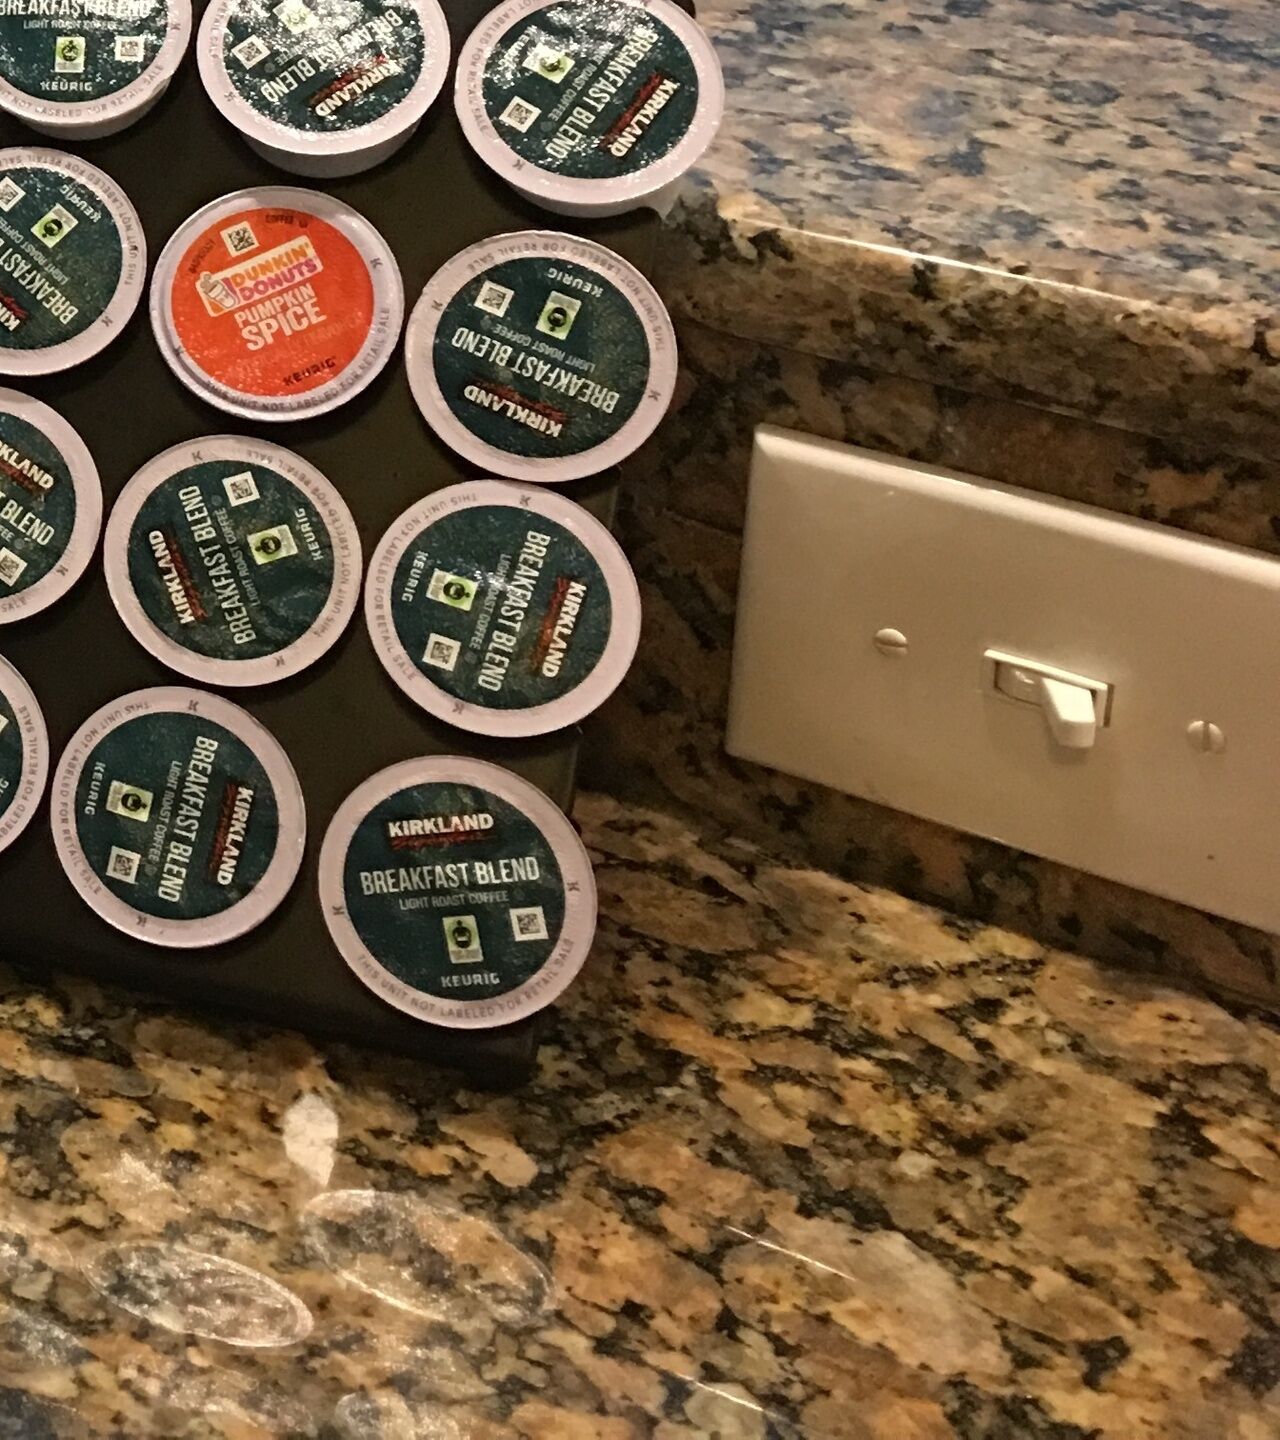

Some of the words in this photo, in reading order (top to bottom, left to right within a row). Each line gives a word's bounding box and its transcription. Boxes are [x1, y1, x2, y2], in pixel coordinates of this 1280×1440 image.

[40, 81, 93, 91] KEURIG
[260, 61, 316, 101] BLEND
[315, 60, 402, 117] KIRKLAND
[583, 26, 659, 112] BREAKFAST
[548, 85, 577, 121] COFFEE
[610, 78, 678, 158] KIRKLAND
[545, 106, 596, 159] BLEND
[60, 184, 102, 224] KEURIG
[230, 242, 310, 287] DUNKIN'
[239, 258, 317, 301] DONUTS
[547, 267, 604, 298] KEURIG
[234, 283, 316, 328] PUMPKIN
[241, 298, 327, 351] SPICE
[284, 358, 336, 386] KEURIG
[451, 326, 514, 367] BLEND
[464, 384, 563, 438] KIRKLAND
[512, 357, 620, 414] BREAKFAST
[0, 500, 54, 545] BLEND
[178, 485, 216, 543] BLEND
[295, 508, 323, 561] KEURIG
[149, 530, 196, 624] KIRKLAND
[199, 543, 257, 644] BREAKFAST
[402, 551, 429, 603] KEURIG
[501, 530, 551, 632] BREAKFAST
[543, 581, 587, 678] KIRKLAND
[478, 630, 517, 691] BLEND
[85, 762, 106, 815] KEURIG
[173, 735, 218, 842] BREAKFAST
[217, 786, 254, 885] KIRKLAND
[389, 813, 494, 837] KIRKLAND
[158, 840, 192, 903] BLEND
[360, 863, 468, 895] BREAKFAST
[476, 856, 540, 884] BLEND
[441, 972, 500, 987] KEURIG
